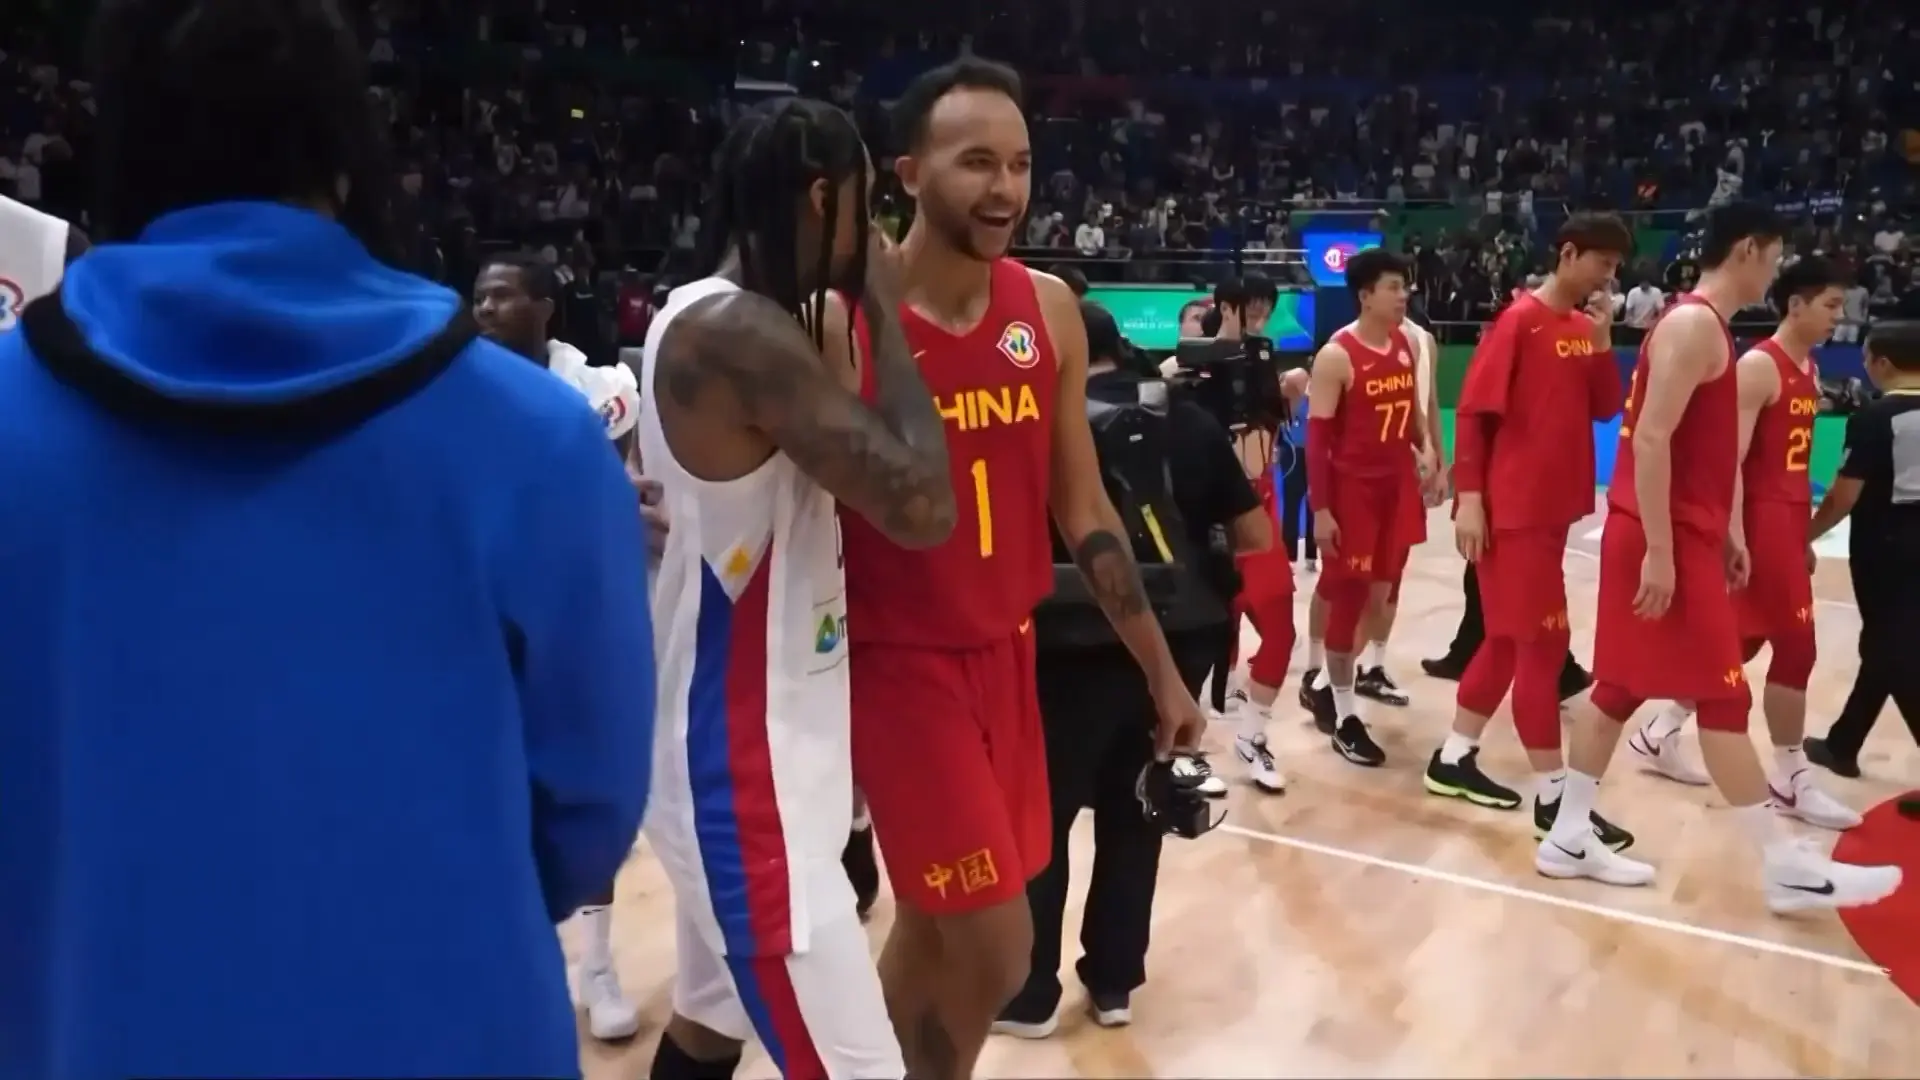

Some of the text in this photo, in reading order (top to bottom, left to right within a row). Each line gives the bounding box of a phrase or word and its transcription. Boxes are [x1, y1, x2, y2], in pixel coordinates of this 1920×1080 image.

[933, 383, 1040, 432] HINA
[1365, 373, 1413, 396] CHINA
[1790, 398, 1817, 416] CHIN
[1374, 399, 1412, 443] 77
[971, 458, 993, 559] 1
[922, 847, 1000, 901] 中国
